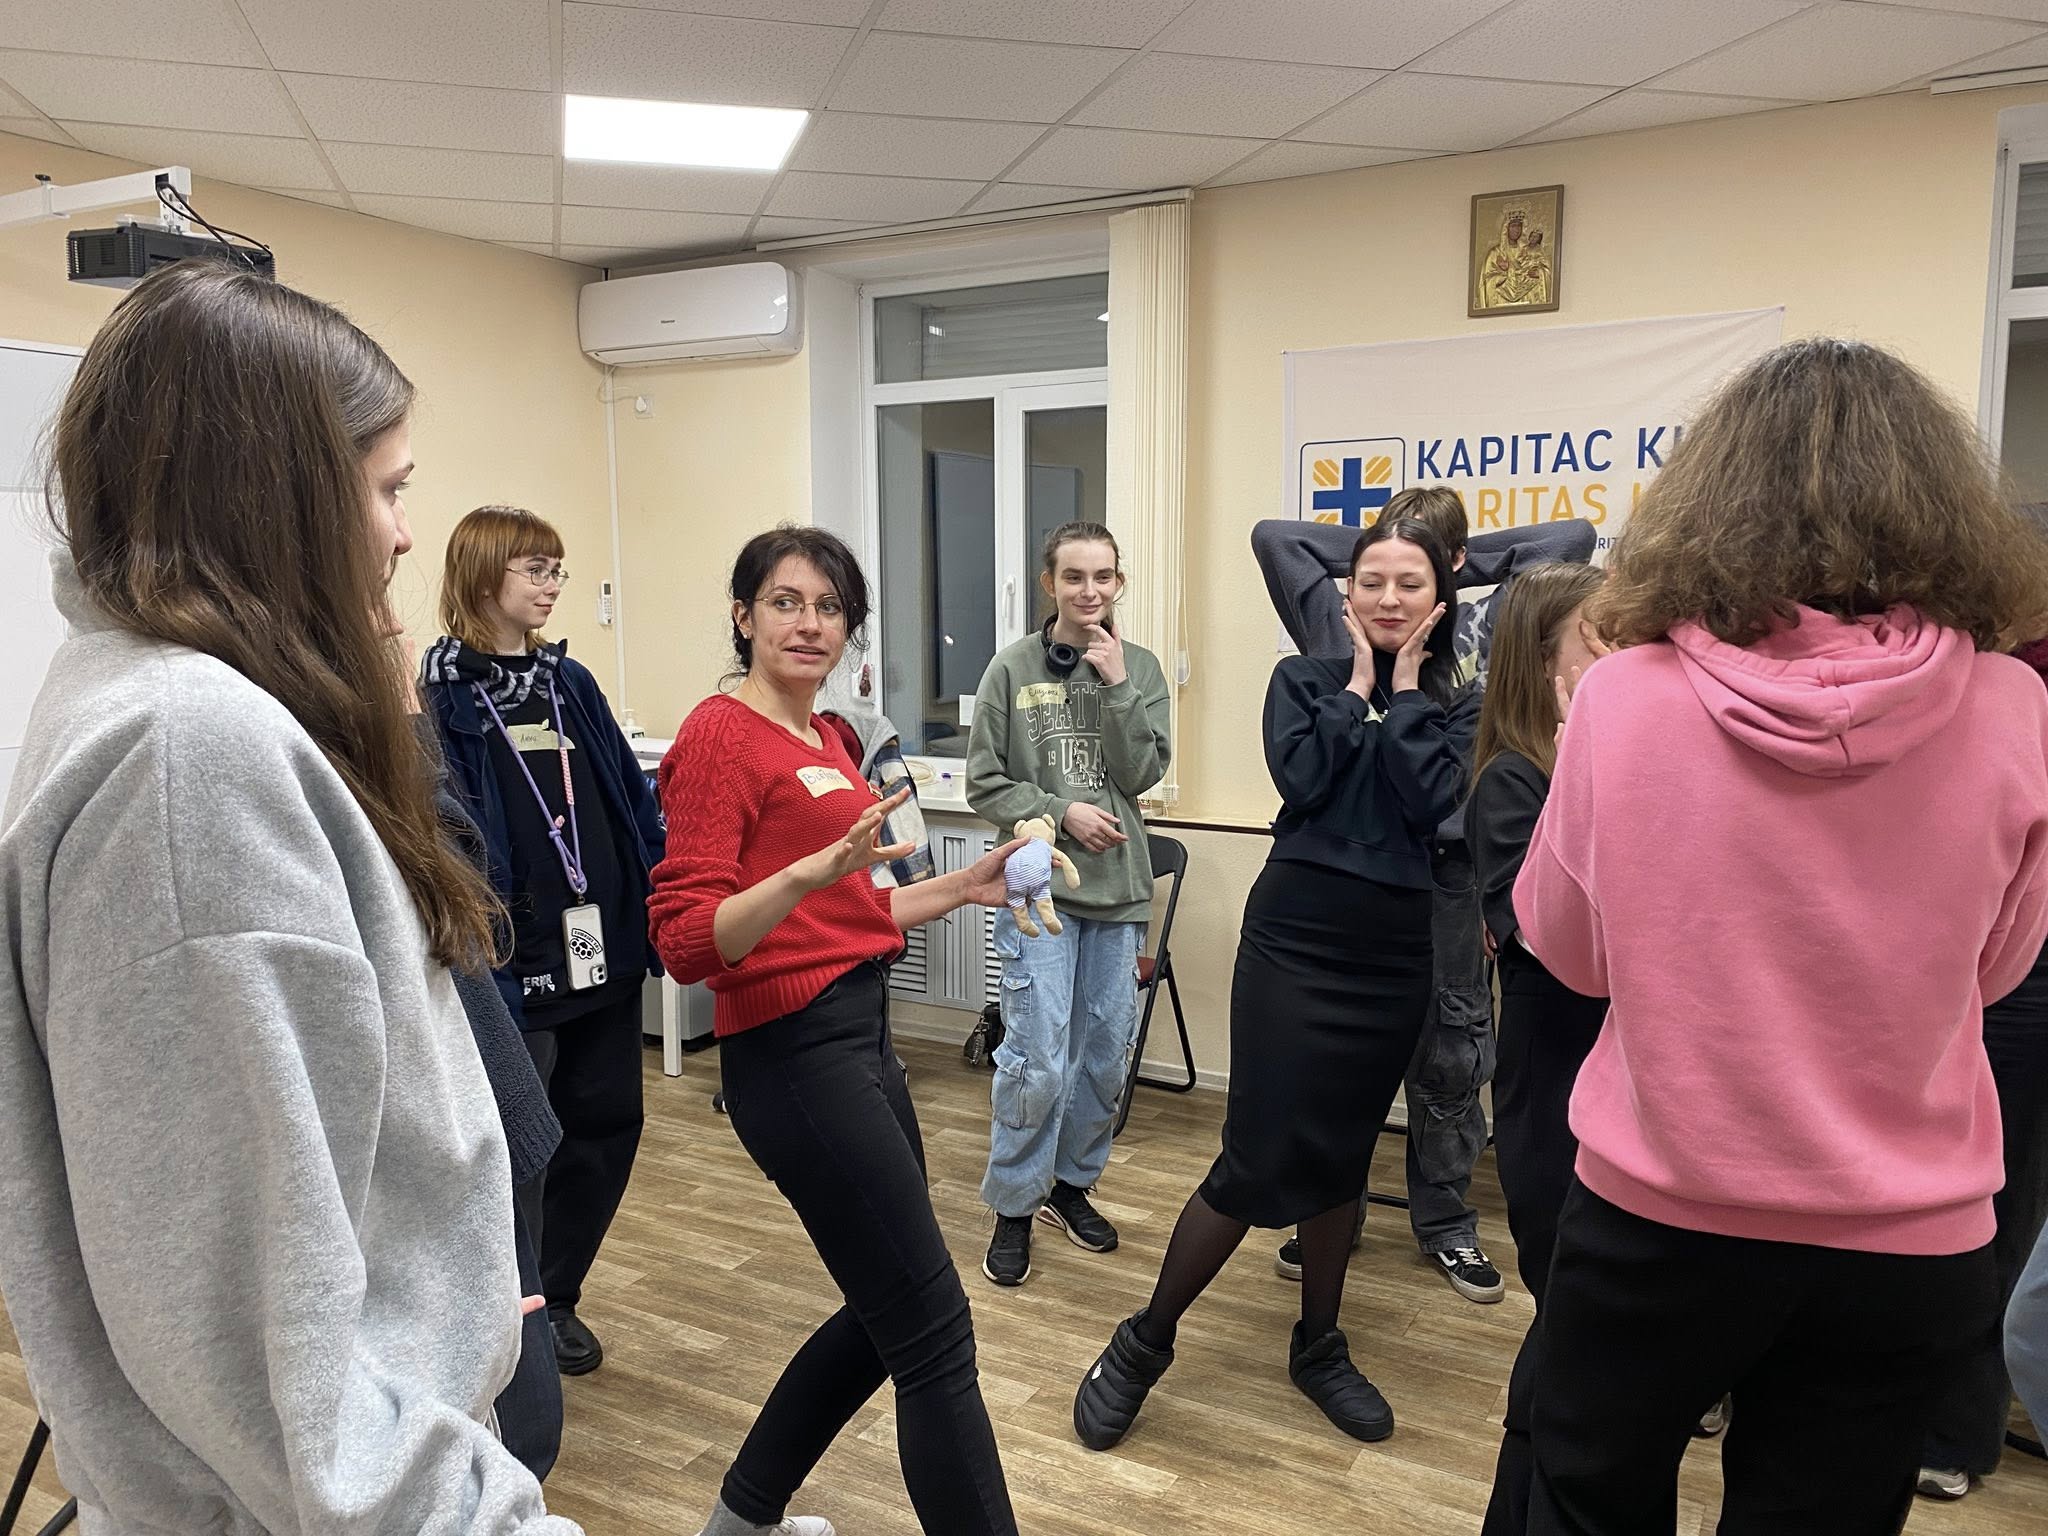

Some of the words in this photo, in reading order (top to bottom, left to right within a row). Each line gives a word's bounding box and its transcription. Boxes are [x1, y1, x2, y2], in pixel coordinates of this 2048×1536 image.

[1417, 429, 1613, 480] КАРІТАС
[1048, 750, 1057, 766] 19
[1060, 738, 1102, 775] USA
